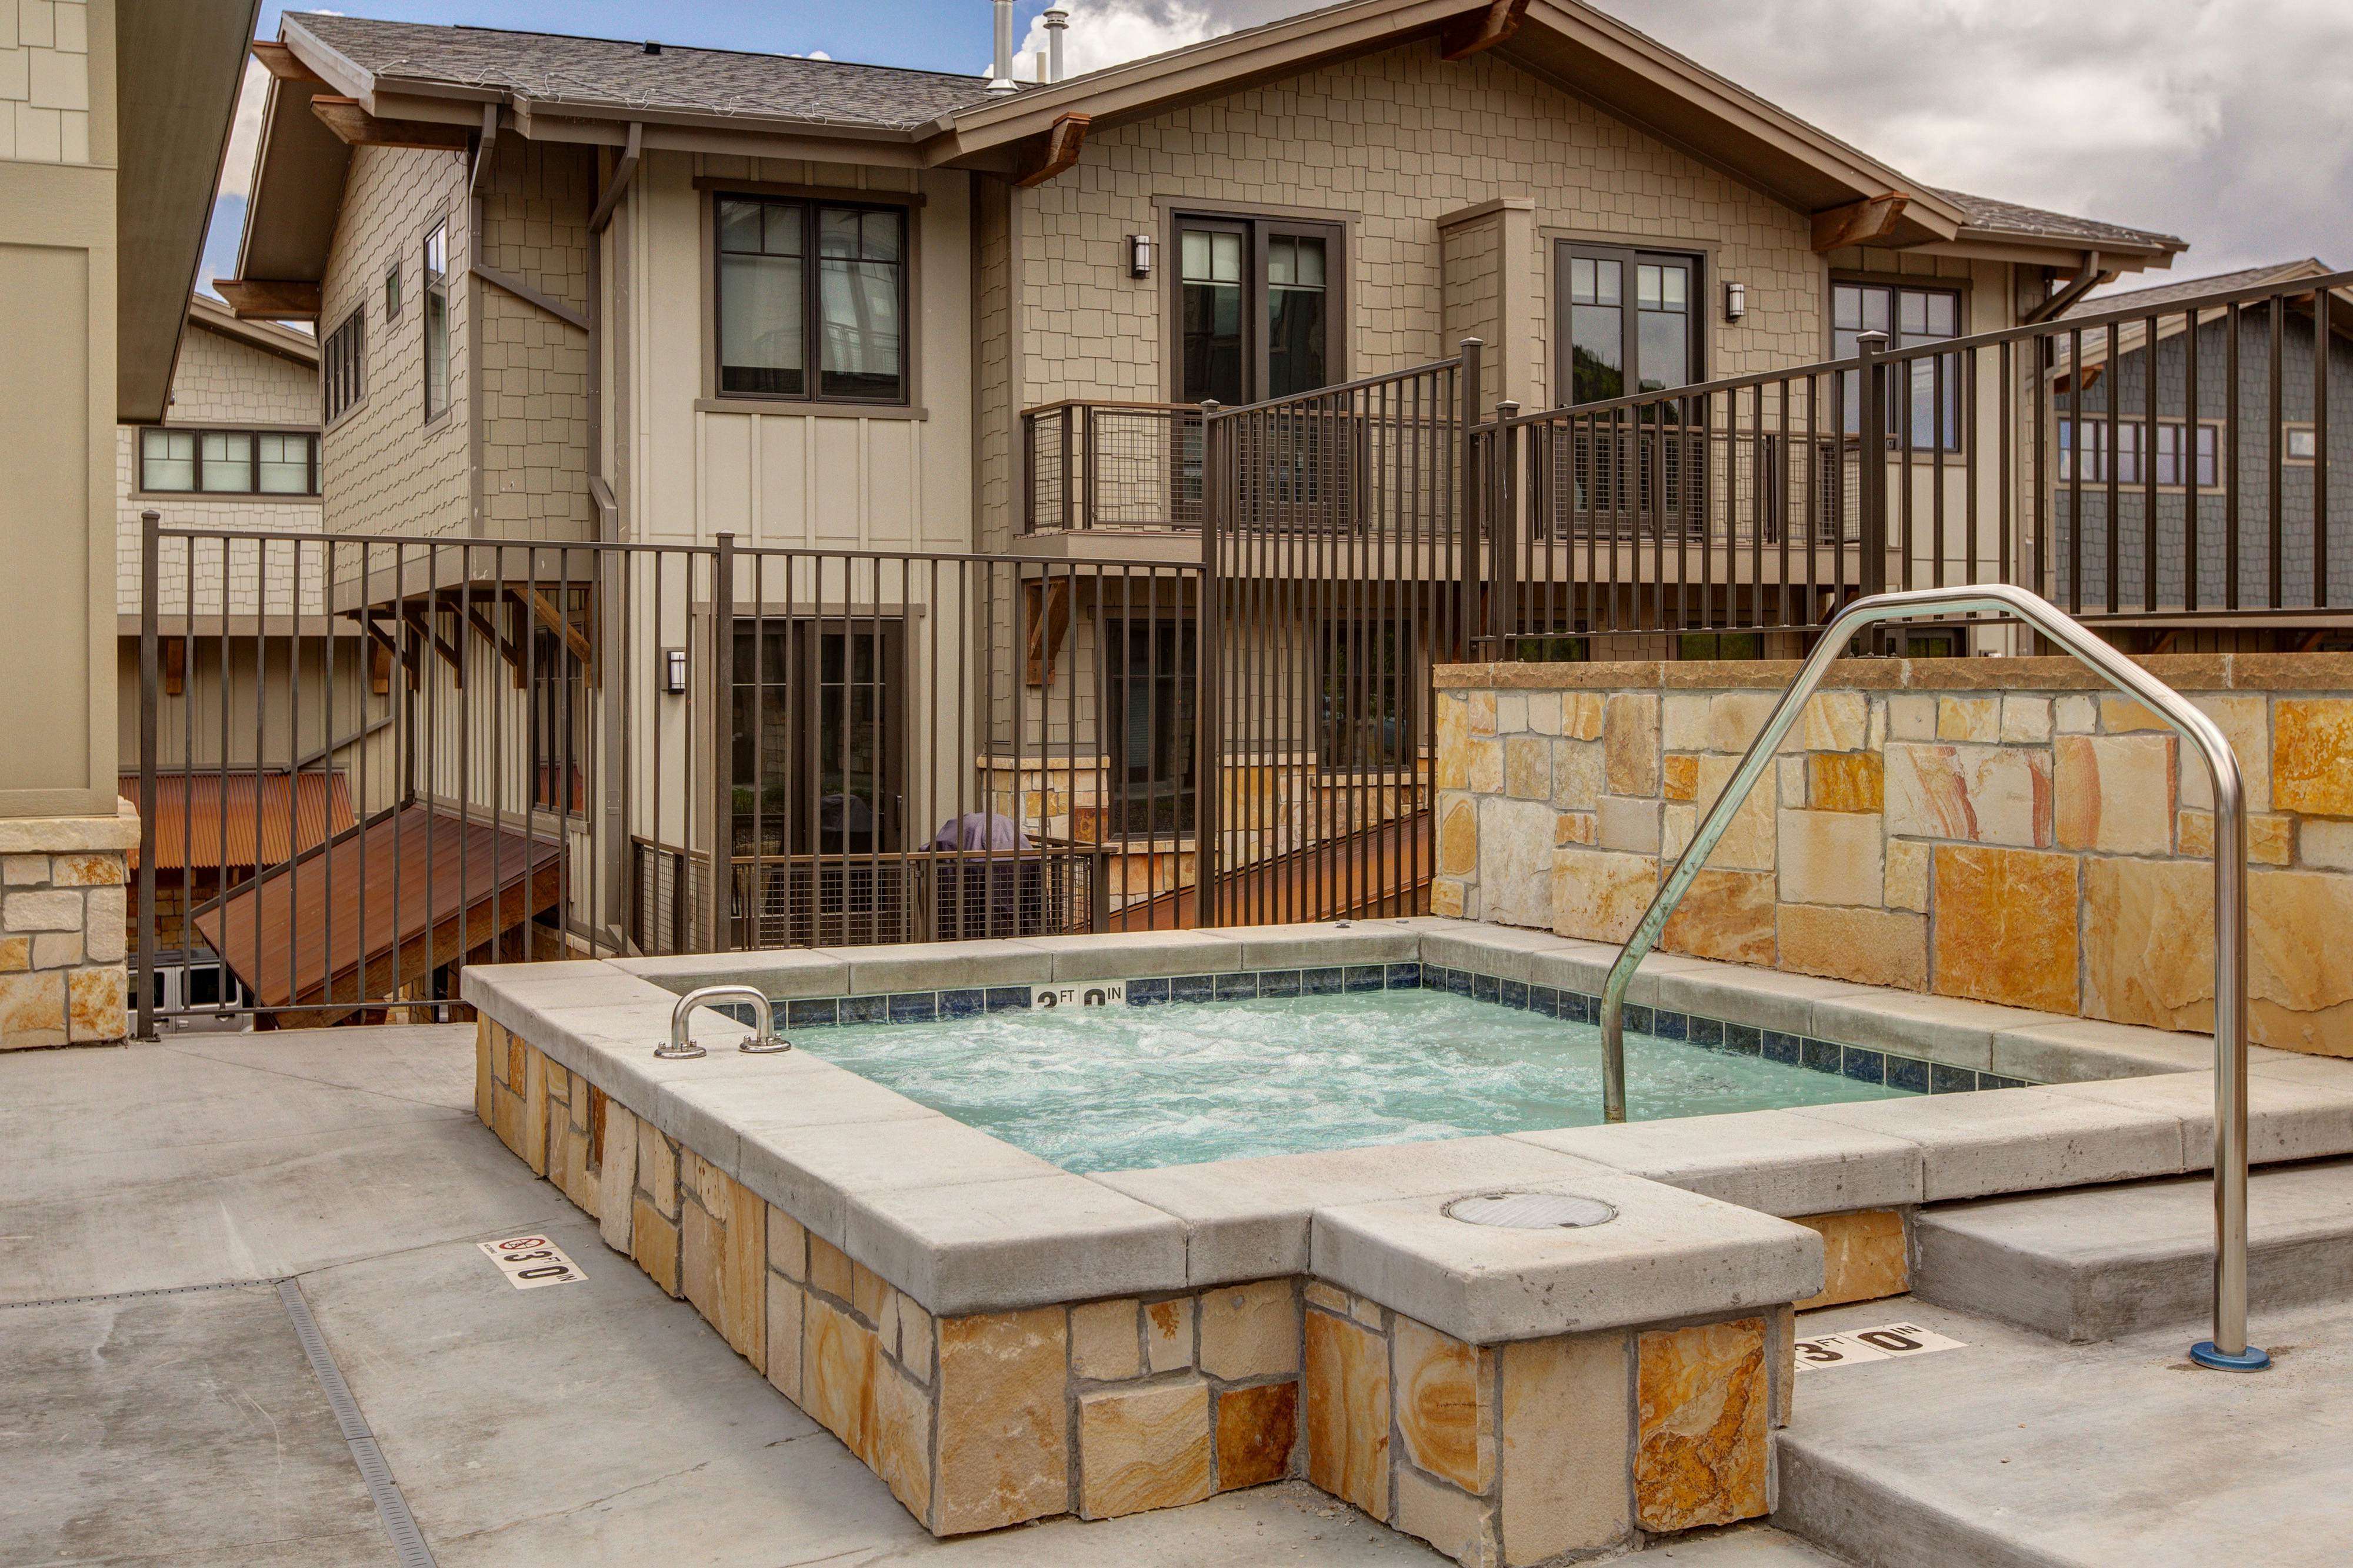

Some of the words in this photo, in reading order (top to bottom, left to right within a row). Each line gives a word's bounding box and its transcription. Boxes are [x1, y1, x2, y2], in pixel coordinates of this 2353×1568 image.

[1060, 990, 1075, 1002] FT
[1108, 987, 1121, 1000] IN
[504, 1250, 553, 1262] 3
[518, 1266, 569, 1280] 0
[556, 1273, 578, 1282] IN
[1890, 1325, 1924, 1335] IN
[1814, 1337, 1845, 1347] FT
[1857, 1331, 1924, 1351] 0
[1794, 1343, 1844, 1362] 3
